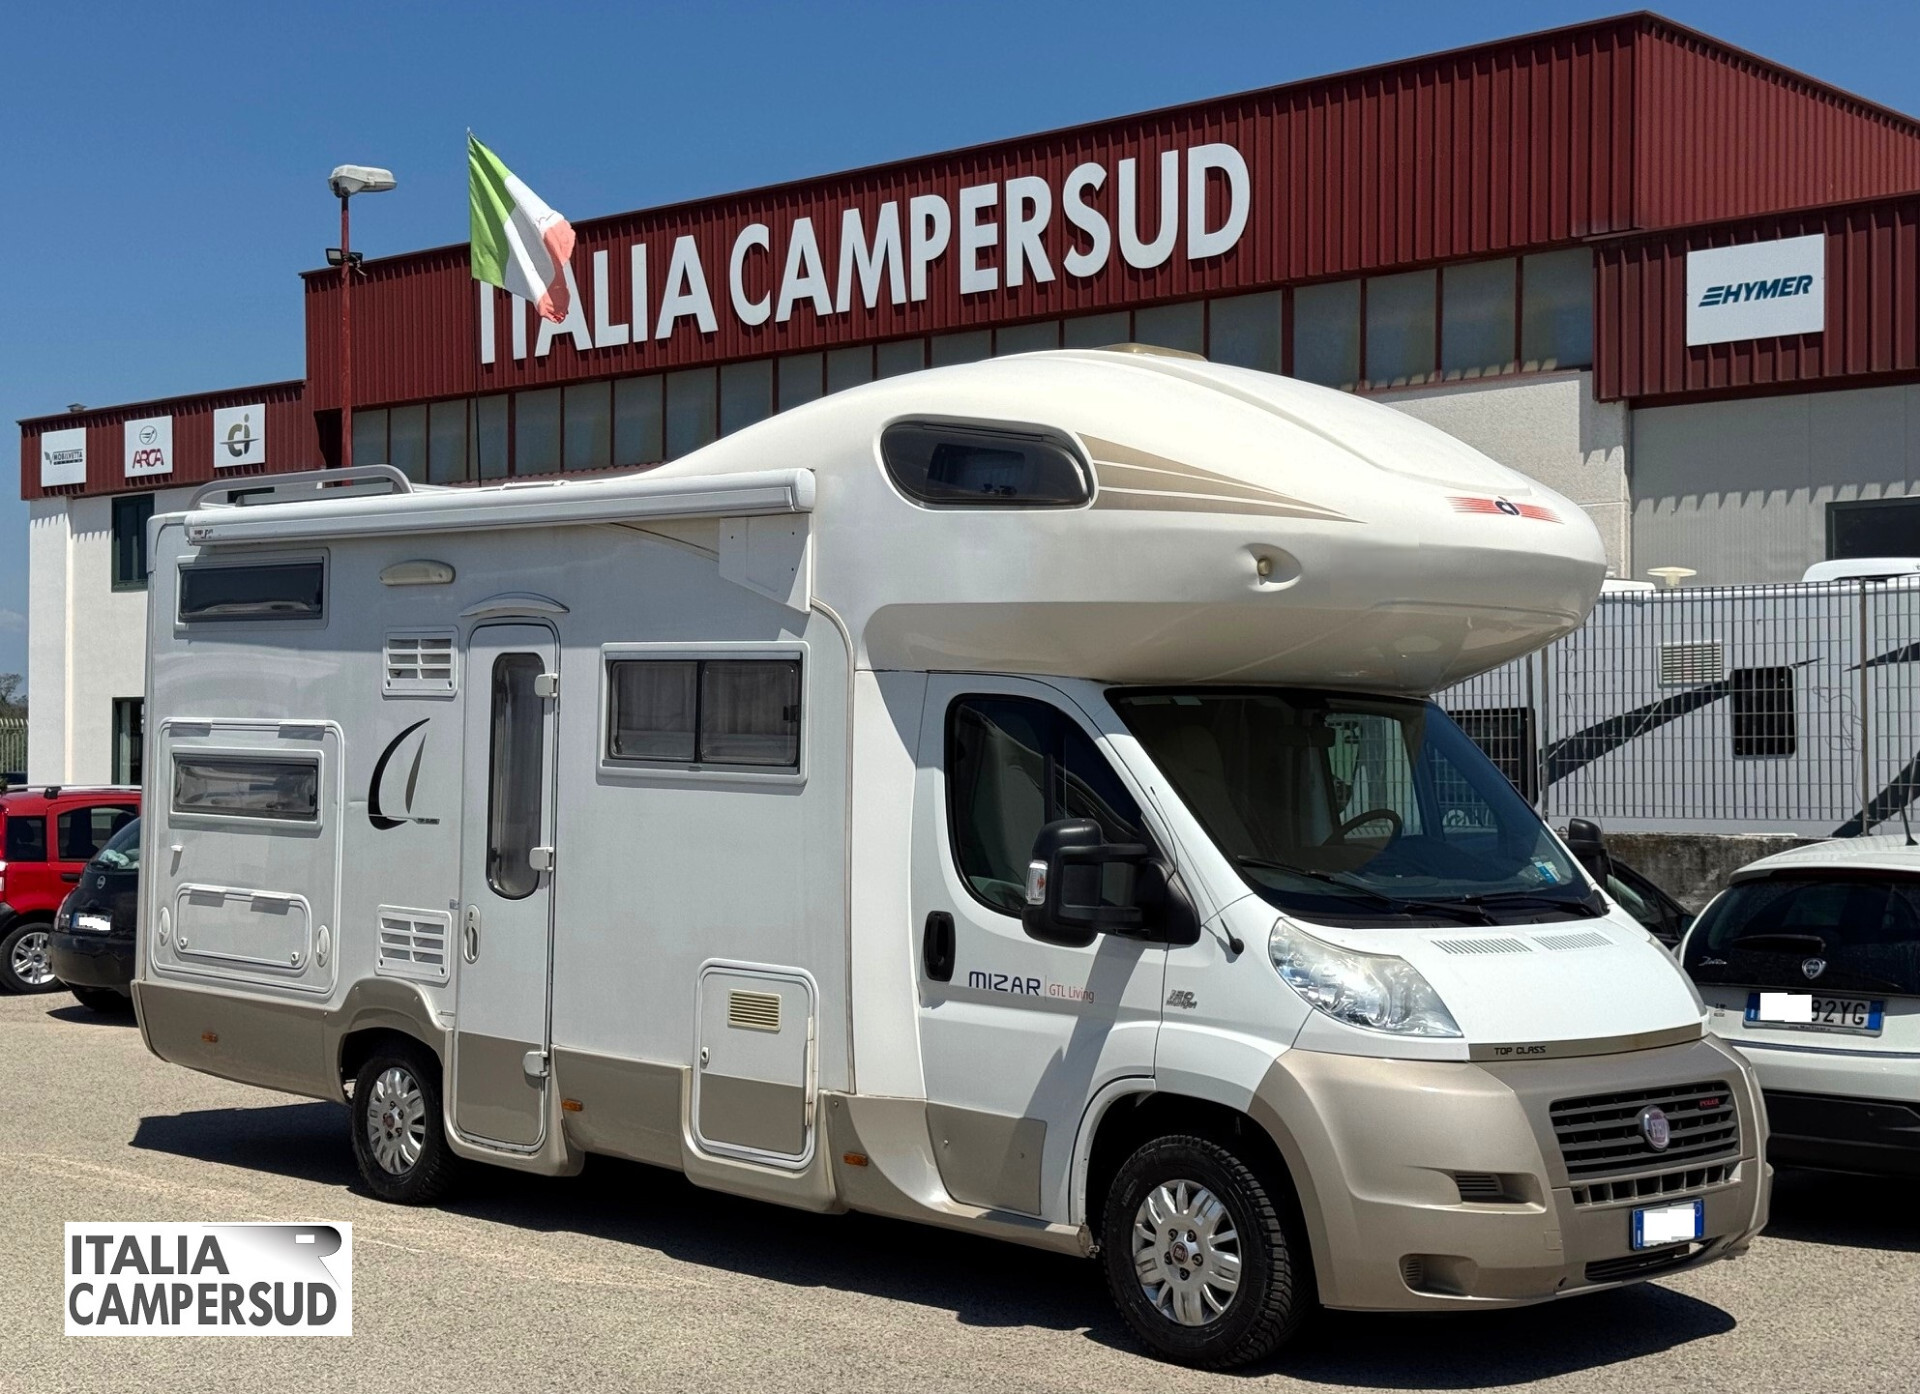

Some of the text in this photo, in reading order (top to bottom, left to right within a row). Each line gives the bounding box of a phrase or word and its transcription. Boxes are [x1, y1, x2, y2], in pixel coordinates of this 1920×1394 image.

[729, 143, 1250, 326] CAMPERSUD
[1720, 274, 1813, 305] HYMER
[132, 448, 164, 469] ARCA
[969, 971, 1041, 996] MIZAR
[1049, 984, 1095, 1004] GTL Living
[1494, 1045, 1546, 1055] TOP CLASS
